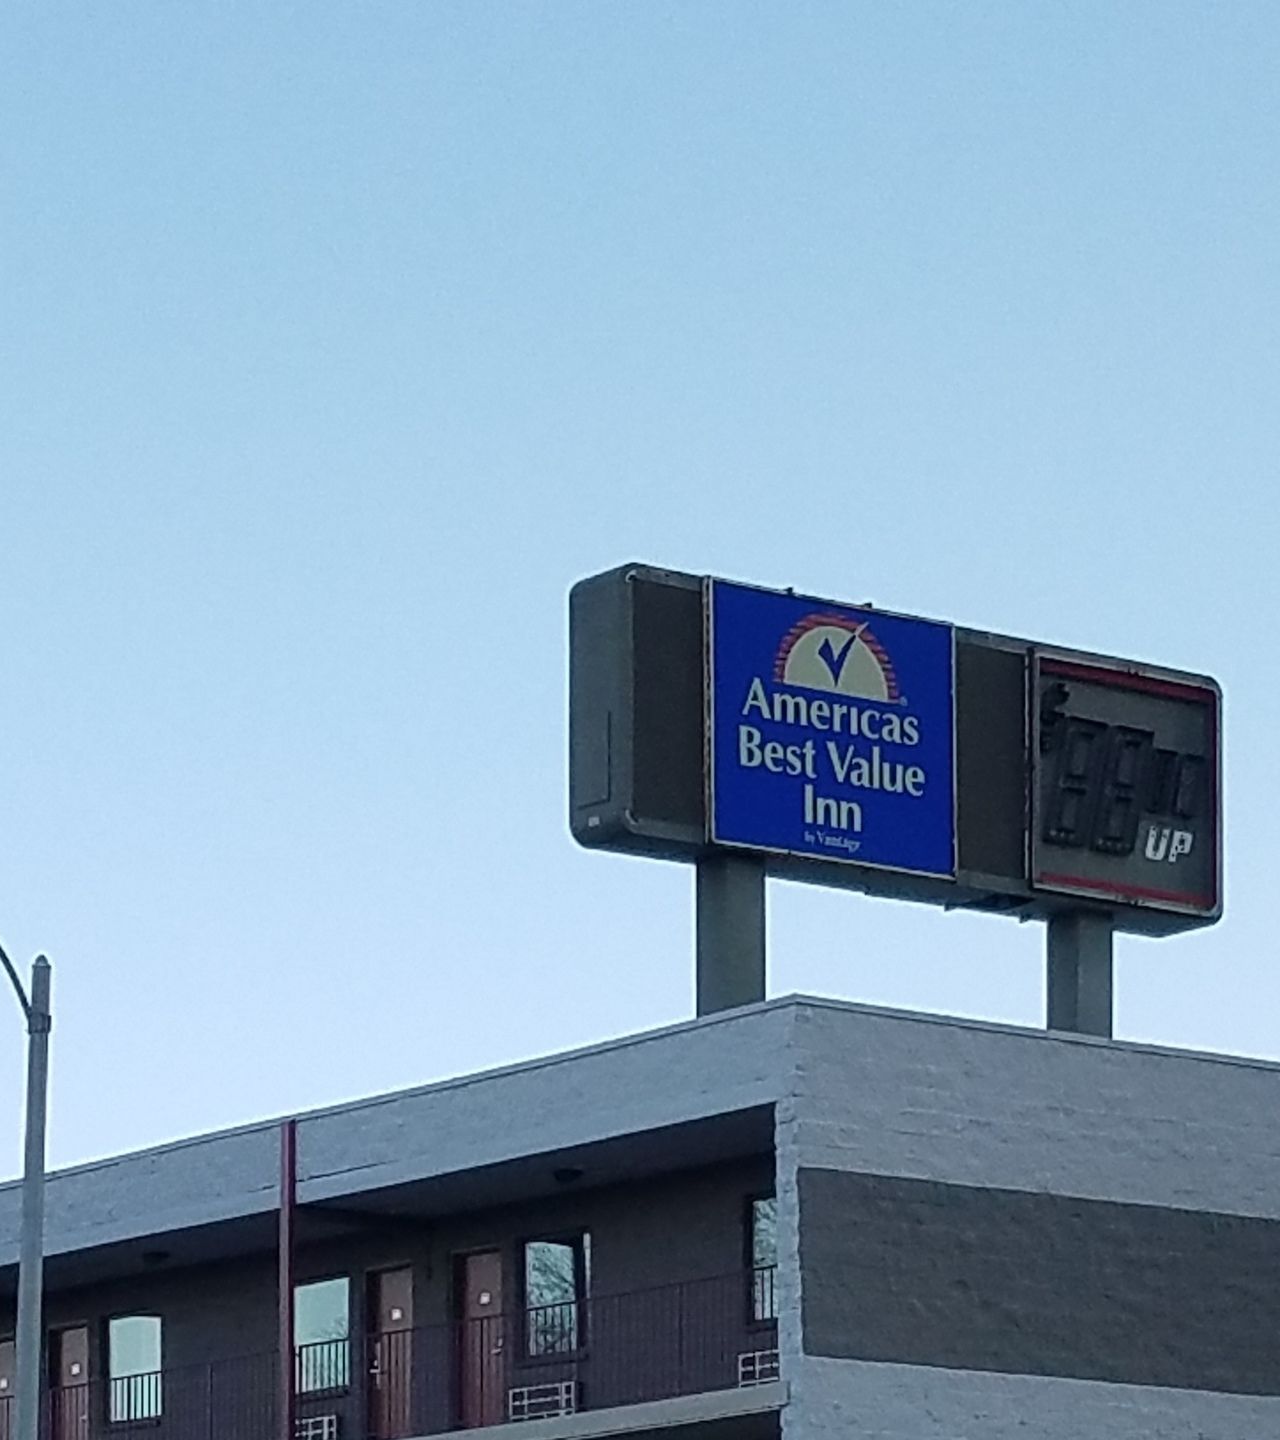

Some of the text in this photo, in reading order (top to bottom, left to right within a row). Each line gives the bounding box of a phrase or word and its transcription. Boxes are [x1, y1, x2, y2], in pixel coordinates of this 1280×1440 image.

[741, 676, 920, 746] Americas
[738, 724, 926, 797] Best Value
[804, 783, 863, 832] Inn
[1144, 825, 1194, 863] UP
